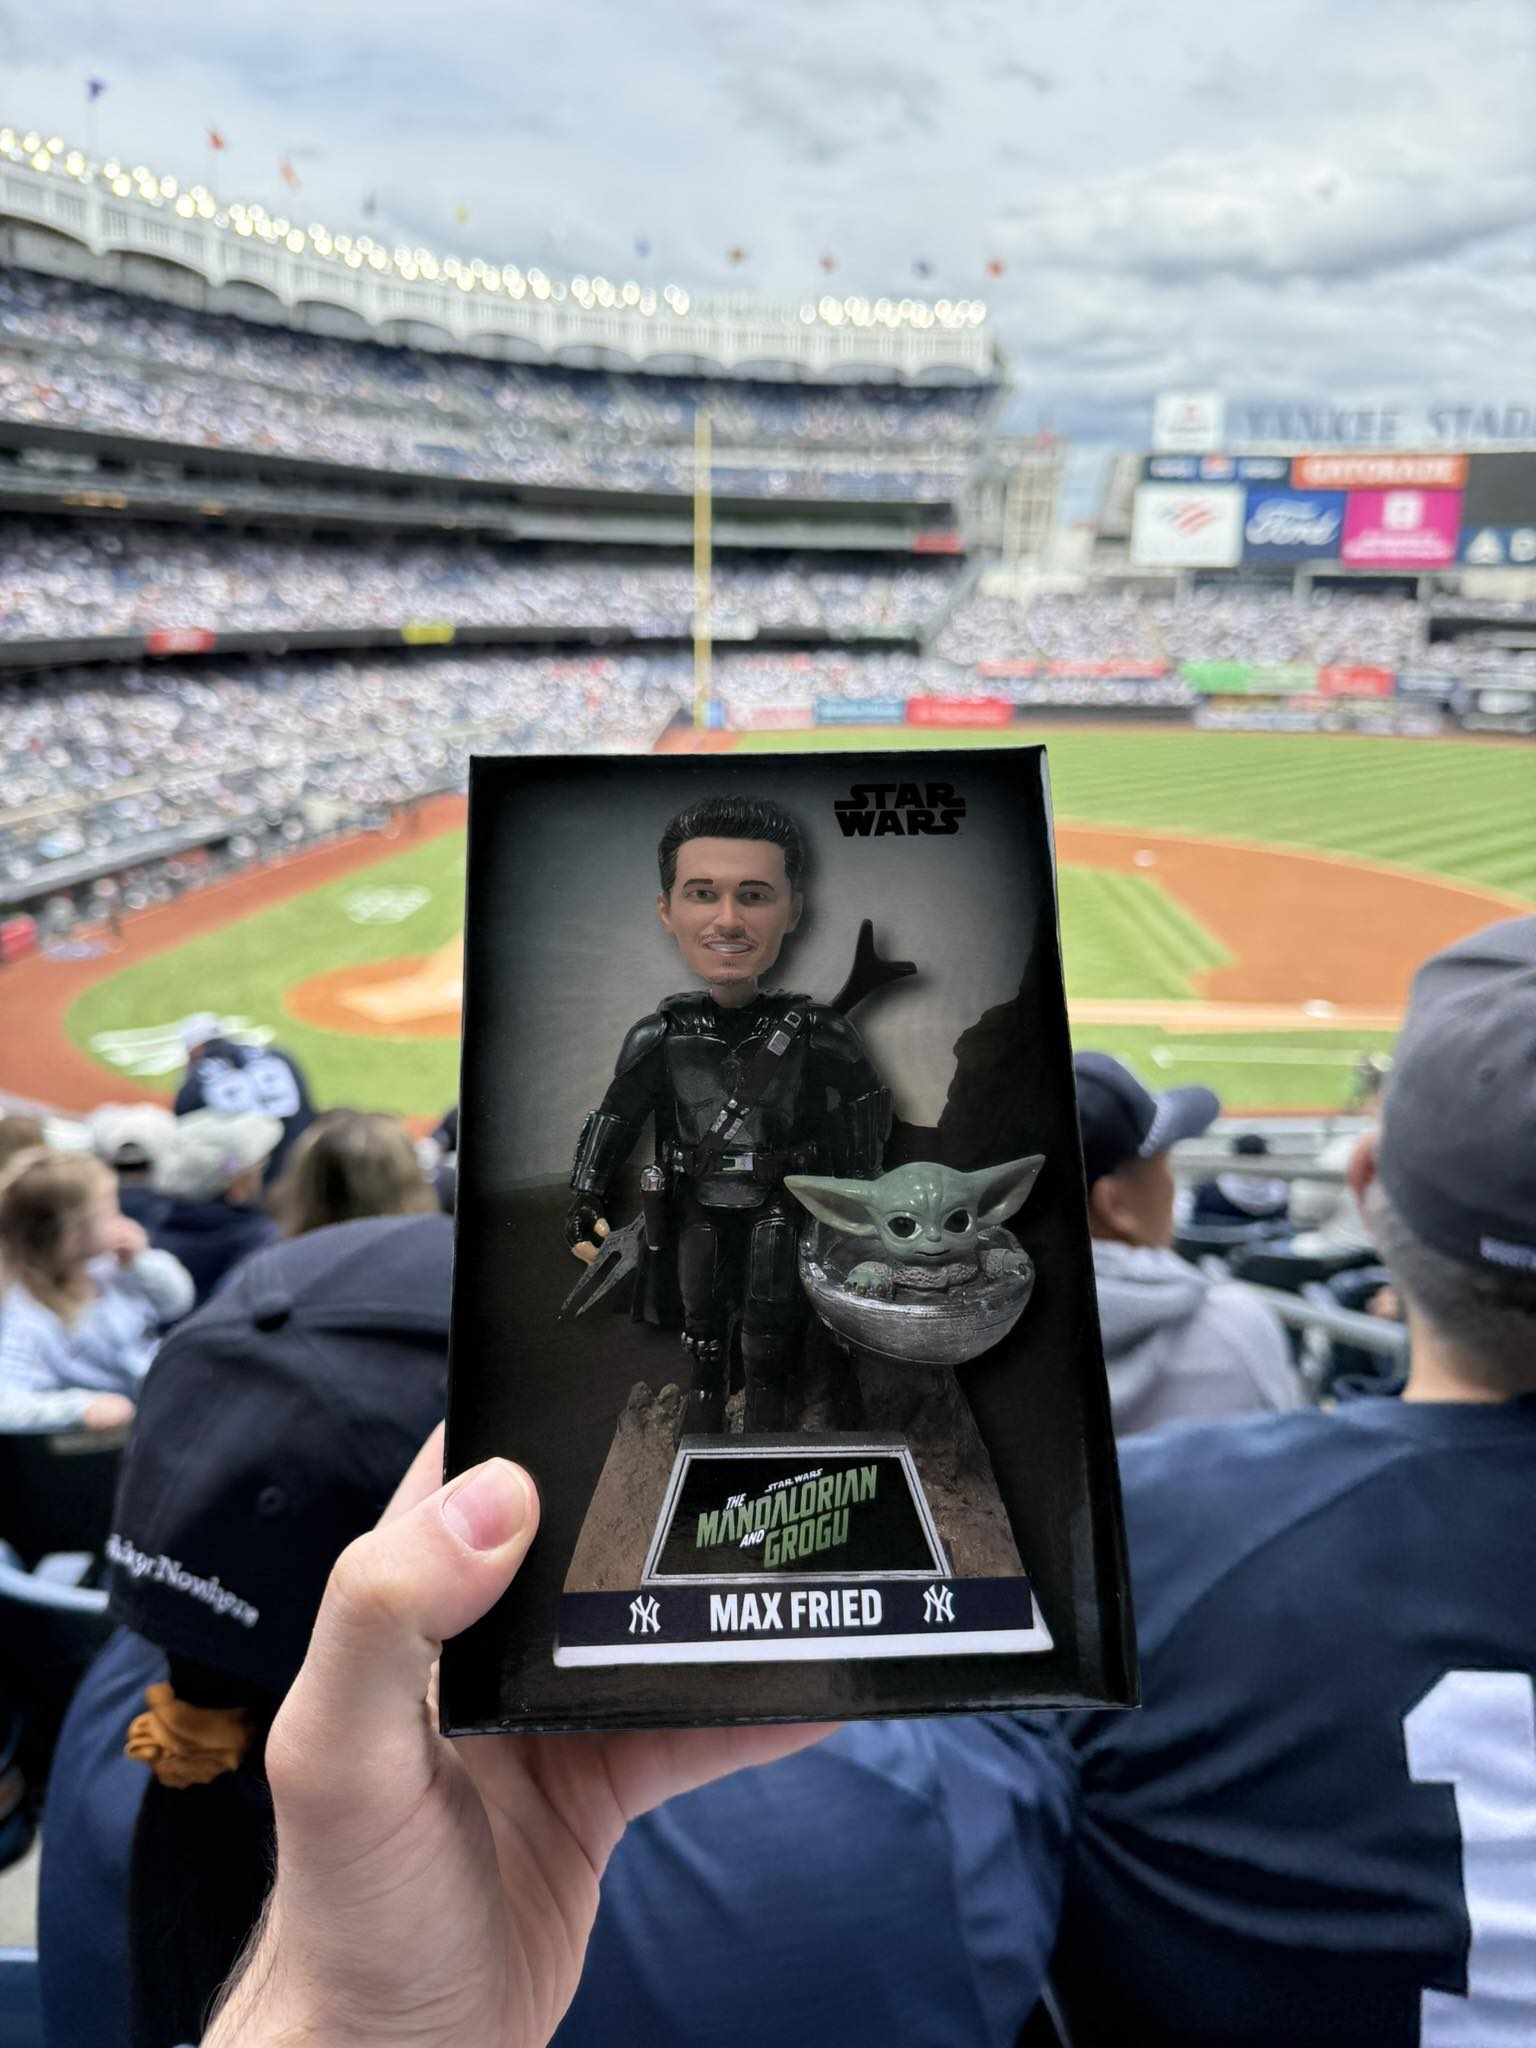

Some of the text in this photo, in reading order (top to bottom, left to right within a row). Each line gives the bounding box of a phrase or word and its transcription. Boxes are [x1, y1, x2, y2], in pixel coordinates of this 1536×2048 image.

[1246, 501, 1341, 545] Ford
[834, 783, 966, 810] STAR
[834, 809, 966, 837] WARS
[765, 1468, 822, 1492] STAR WARS
[696, 1465, 877, 1548] MANDALORIAN
[725, 1492, 747, 1510] THE
[739, 1528, 765, 1549] AND
[763, 1507, 849, 1569] GROGU
[709, 1588, 882, 1631] MAX FRIED
